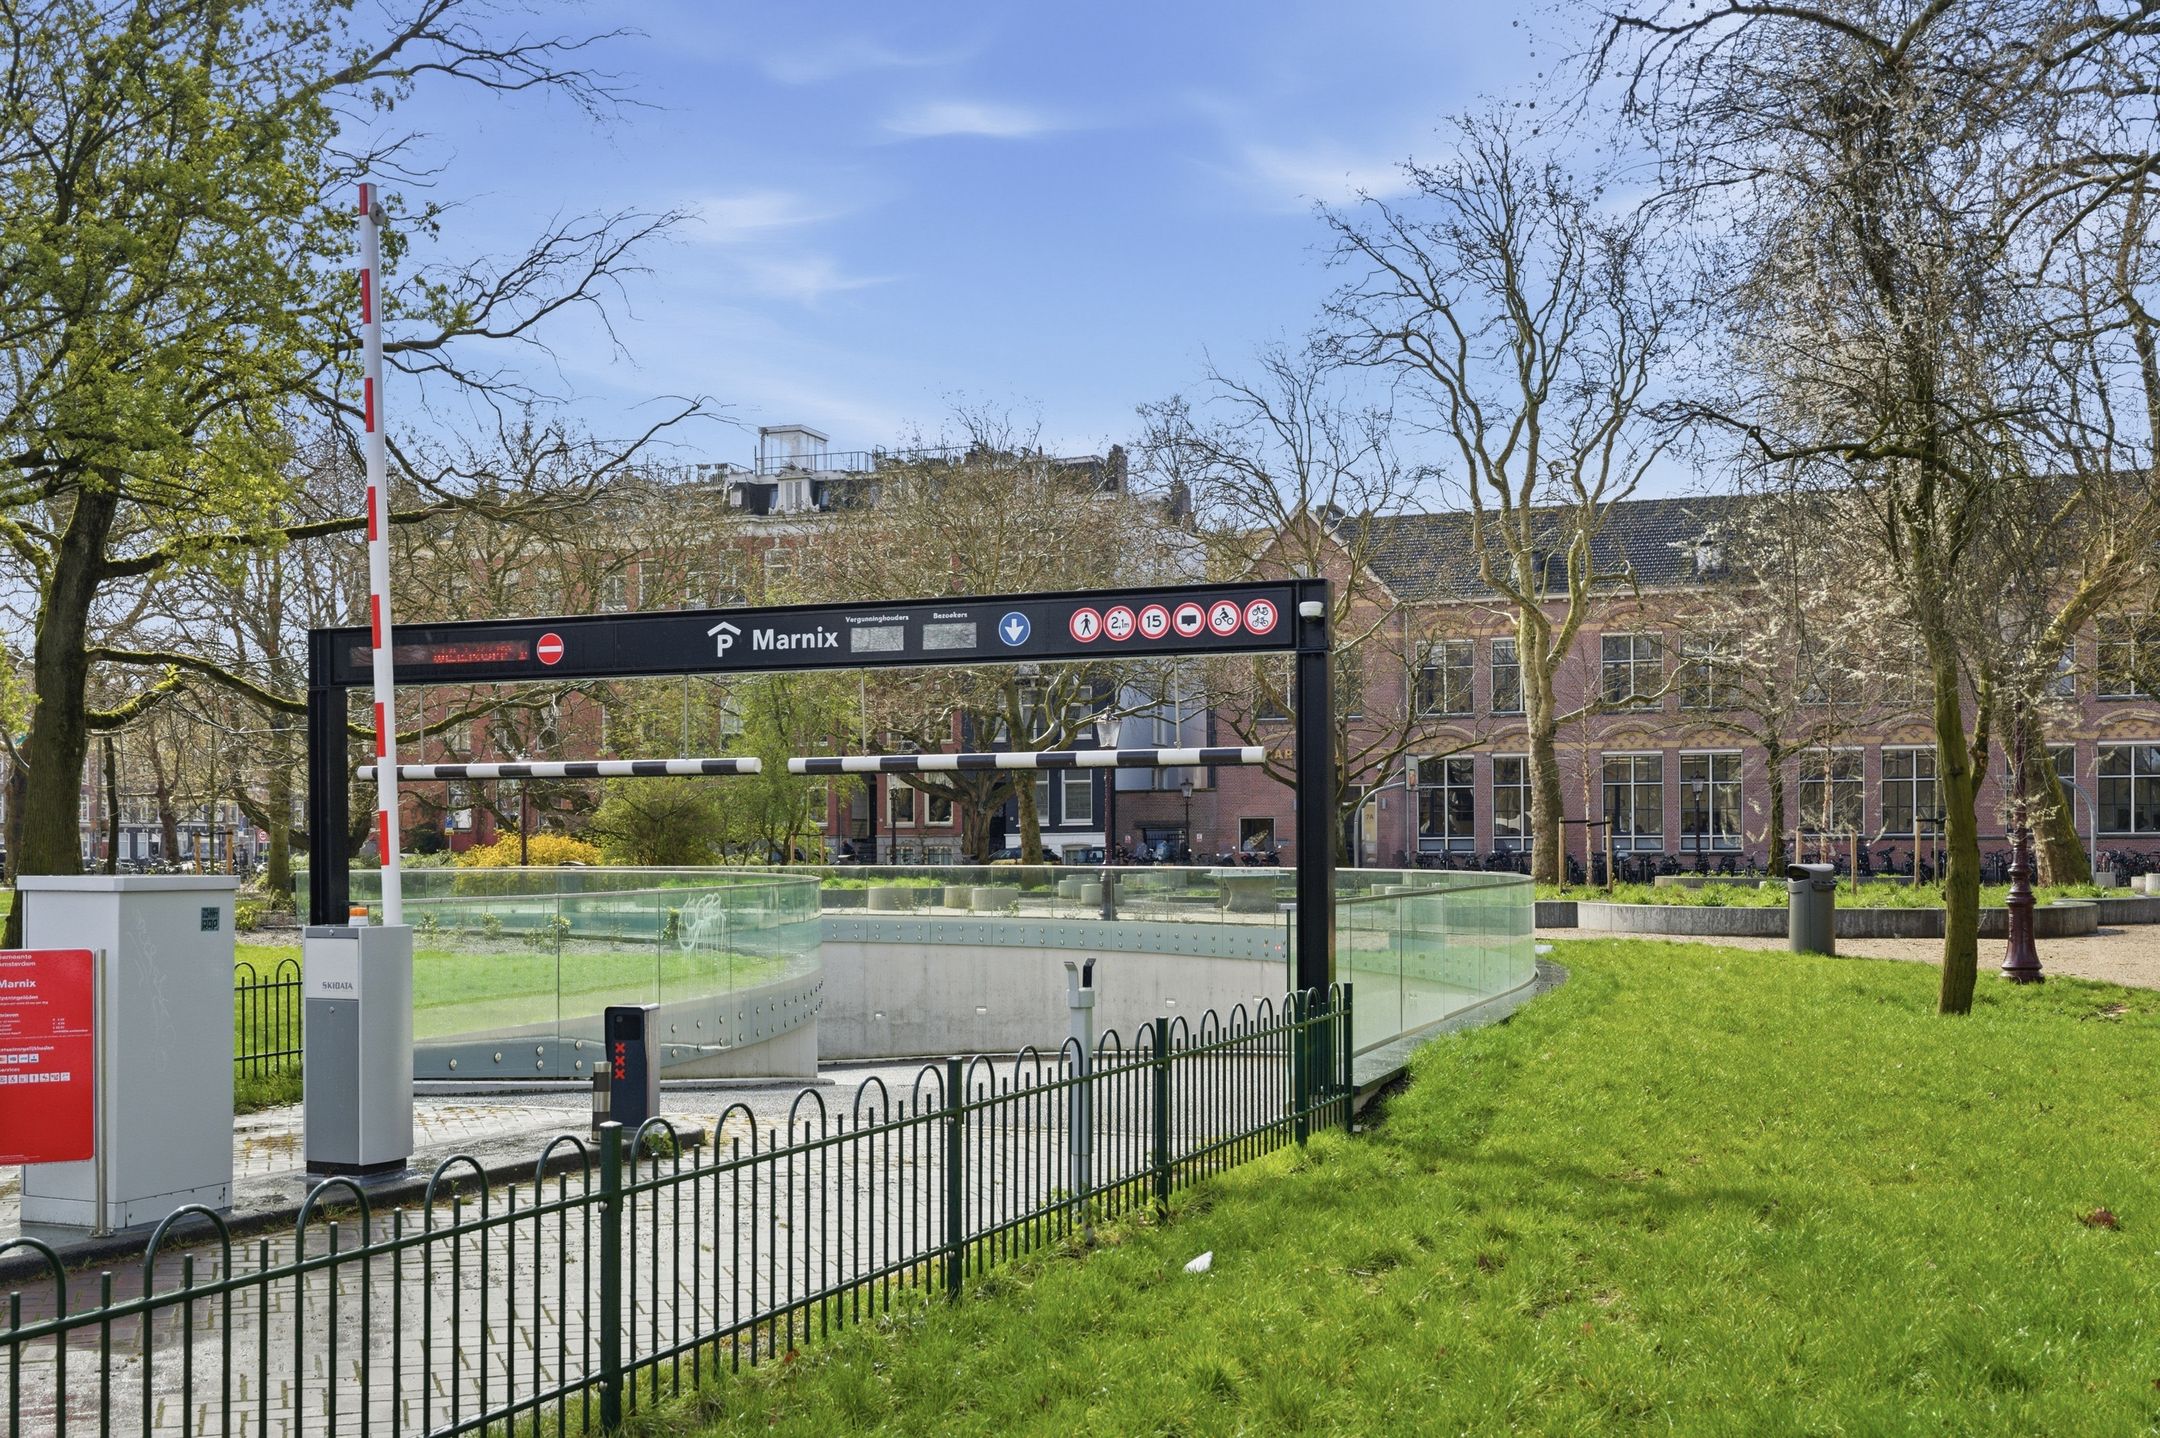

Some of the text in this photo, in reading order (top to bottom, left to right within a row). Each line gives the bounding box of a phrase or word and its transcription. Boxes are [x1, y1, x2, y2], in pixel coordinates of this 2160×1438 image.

[845, 614, 909, 624] Vergunninghouders
[1146, 615, 1162, 628] 15
[752, 626, 839, 650] Marnix
[322, 981, 353, 990] SKIDATA
